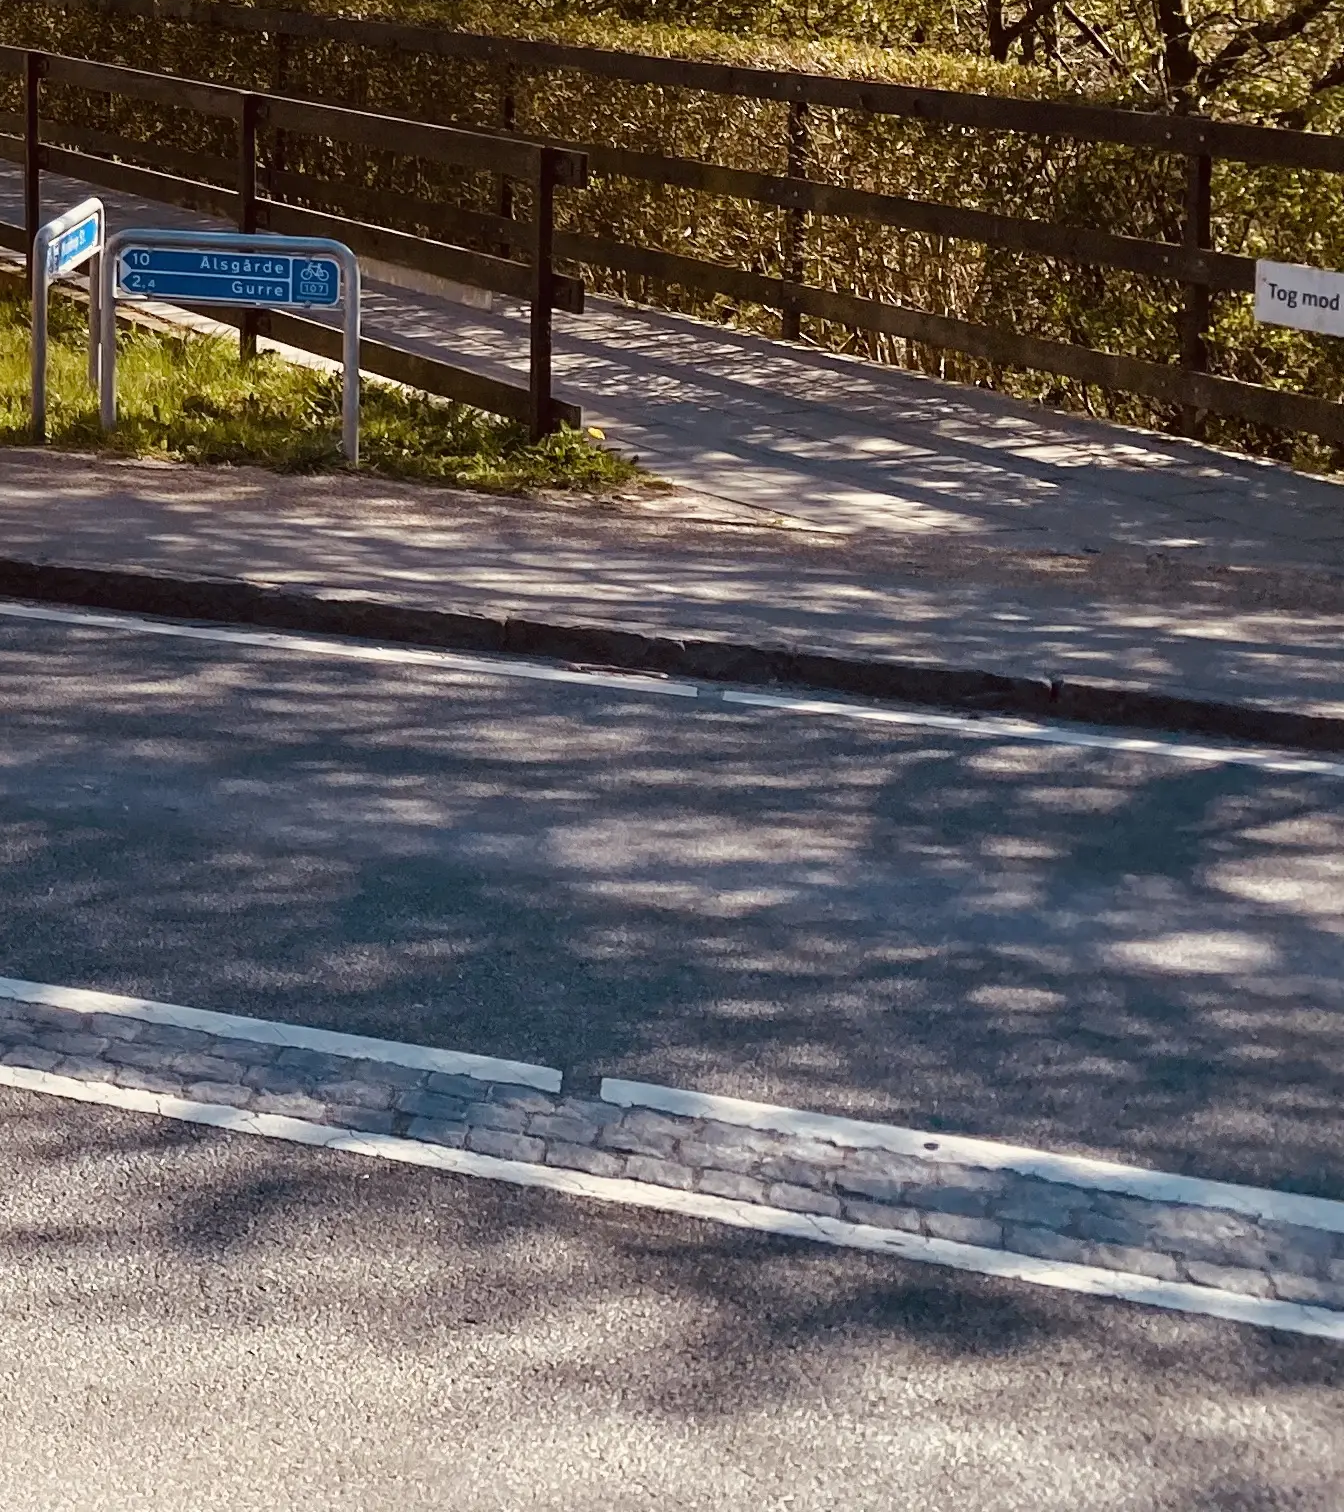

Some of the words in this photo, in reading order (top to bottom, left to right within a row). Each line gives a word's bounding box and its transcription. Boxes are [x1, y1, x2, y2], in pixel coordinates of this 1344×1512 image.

[132, 253, 150, 266] 10
[200, 255, 284, 274] Ålsgårde
[231, 281, 284, 296] Gurre
[304, 284, 324, 293] 107
[1269, 283, 1298, 308] Tog
[1302, 293, 1340, 311] mod
